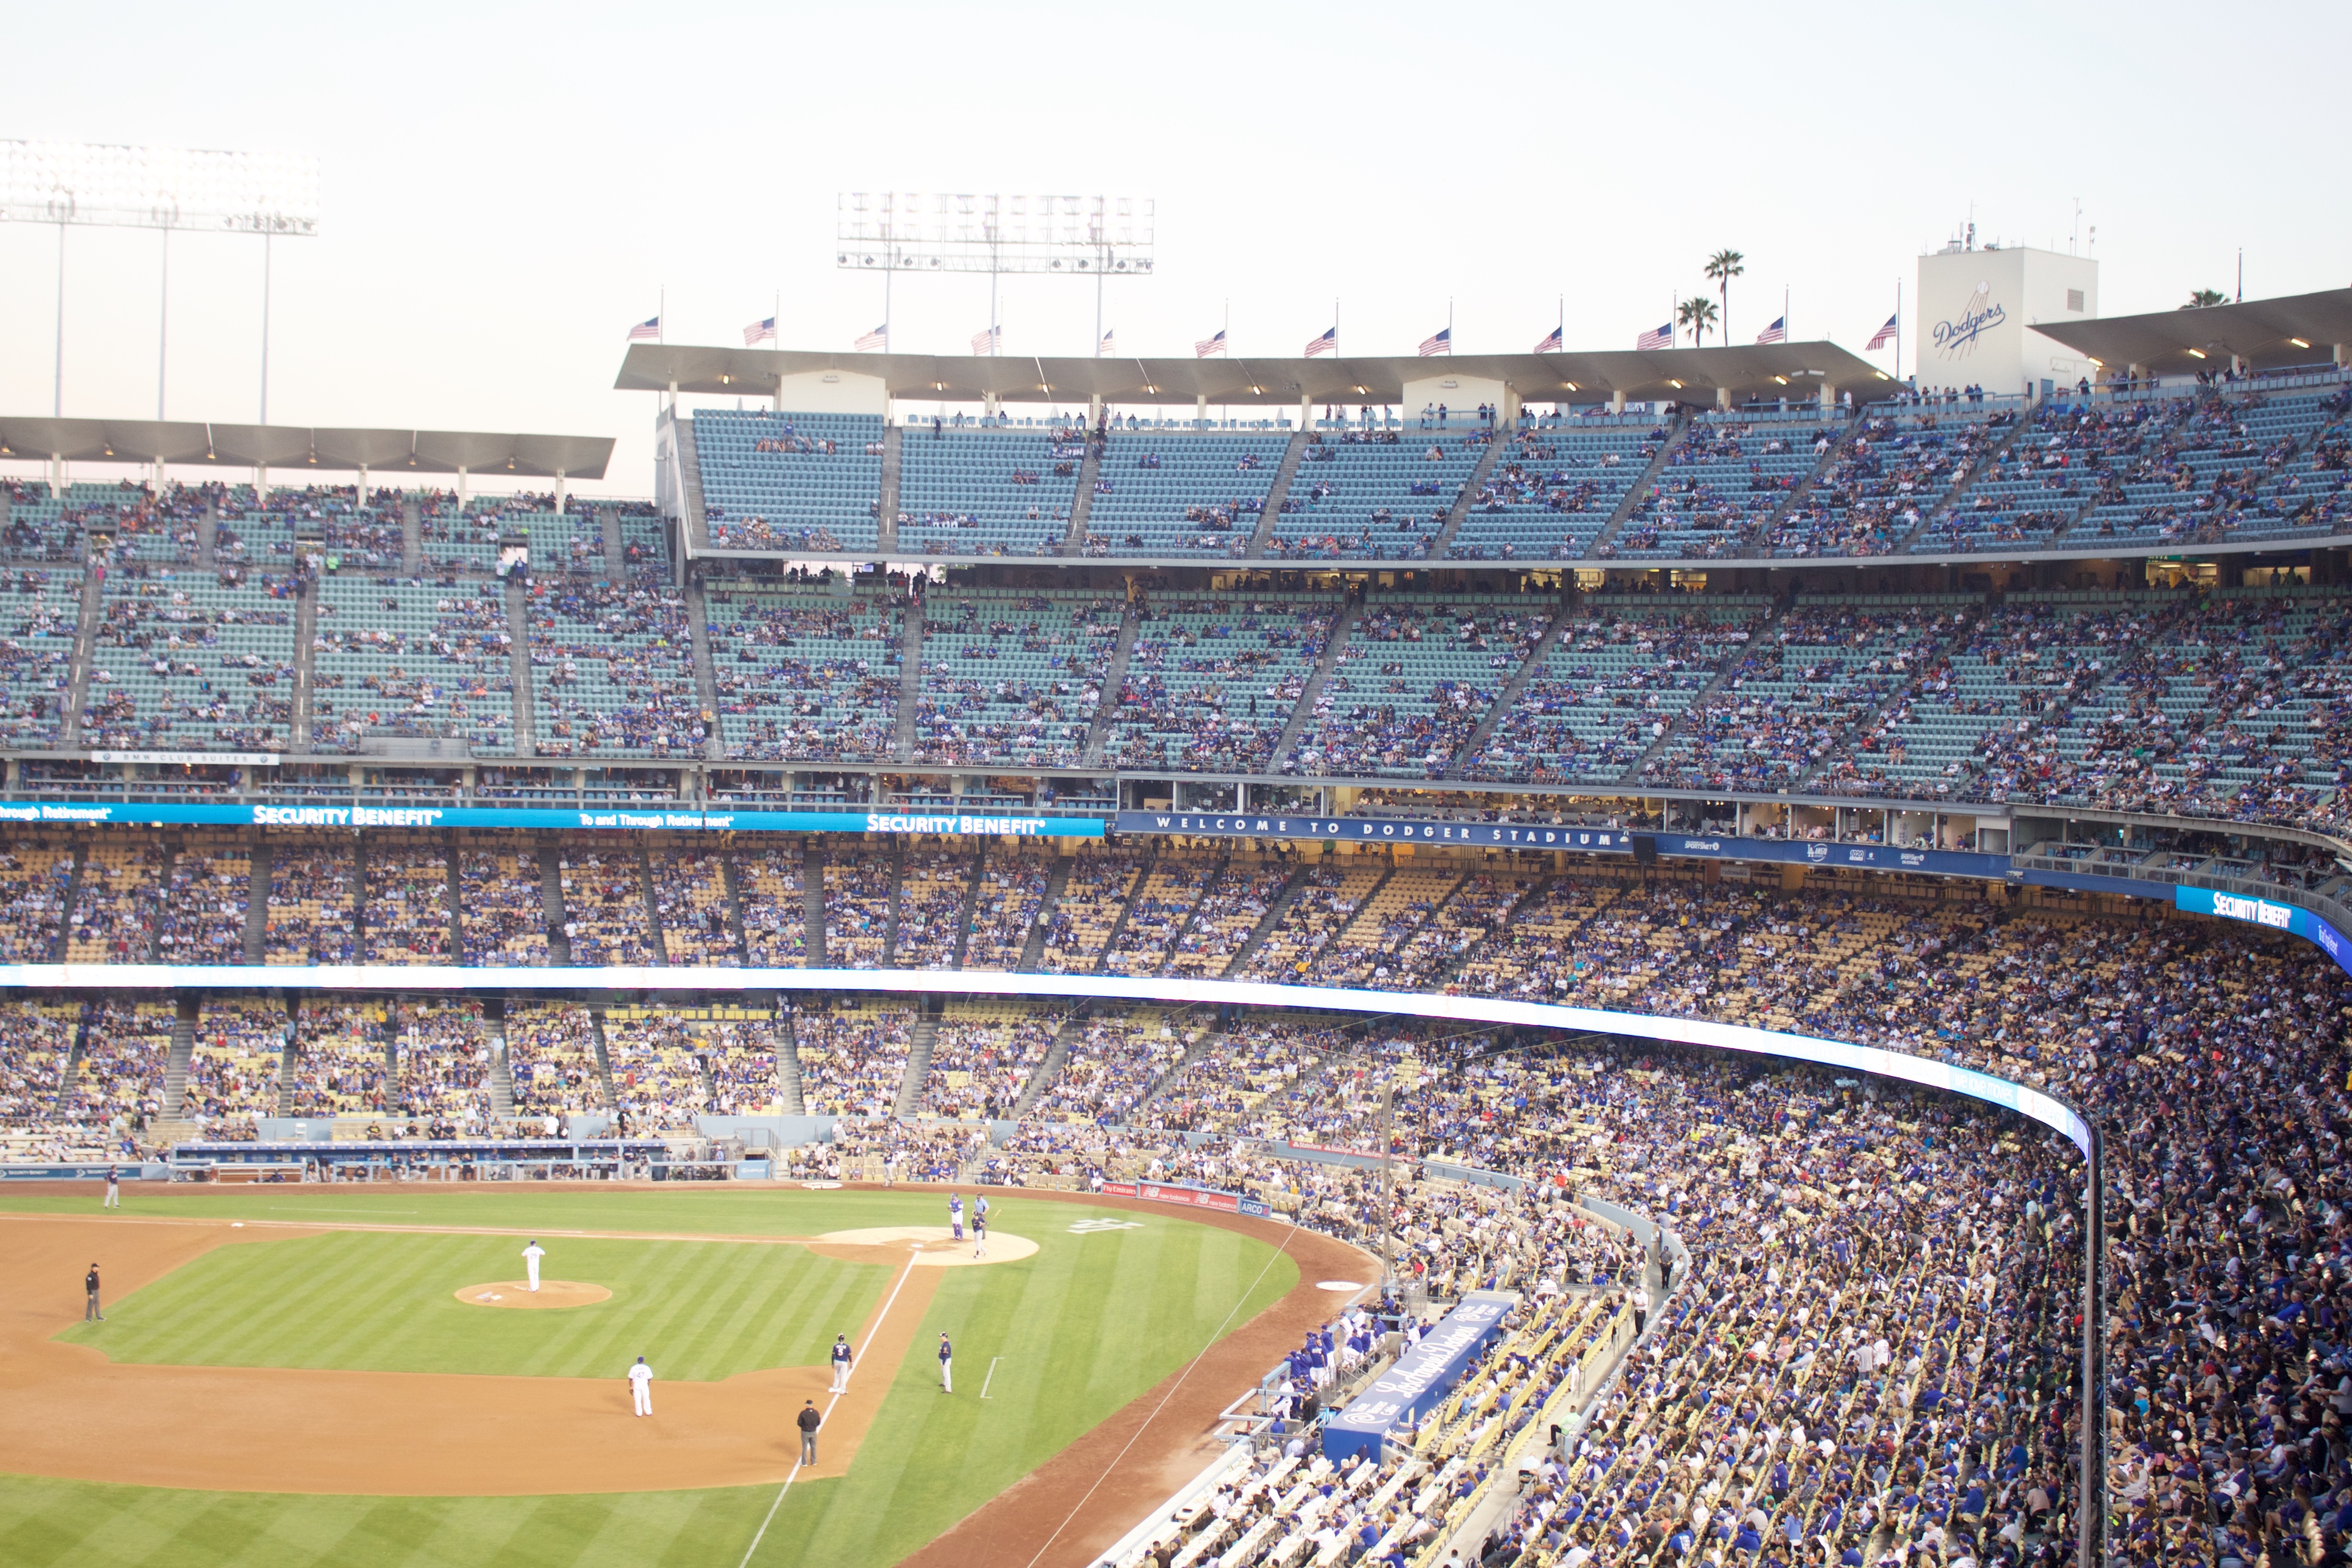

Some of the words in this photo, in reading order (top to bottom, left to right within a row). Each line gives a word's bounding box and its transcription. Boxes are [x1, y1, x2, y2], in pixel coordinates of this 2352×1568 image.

[1933, 304, 2006, 349] Dodgers
[253, 805, 350, 824] SECURITY
[579, 814, 593, 826] To
[595, 815, 616, 826] and
[619, 814, 664, 829] Through
[867, 814, 957, 832] SECURITY
[1157, 817, 1286, 831] WELCOME
[1311, 822, 1339, 834] TO
[1363, 824, 1470, 839] DODGER
[1493, 829, 1611, 846] STADIUM
[1954, 1073, 1967, 1089] we
[1968, 1073, 1986, 1093] love
[1987, 1081, 2013, 1104] movies
[1113, 1186, 1136, 1195] Emirates
[1169, 1193, 1190, 1202] balance
[1218, 1201, 1237, 1209] balance
[1241, 1202, 1263, 1215] ARCO
[1417, 1325, 1480, 1356] Dodgers
[837, 1348, 844, 1357] 5
[1392, 1356, 1446, 1388] Angeles
